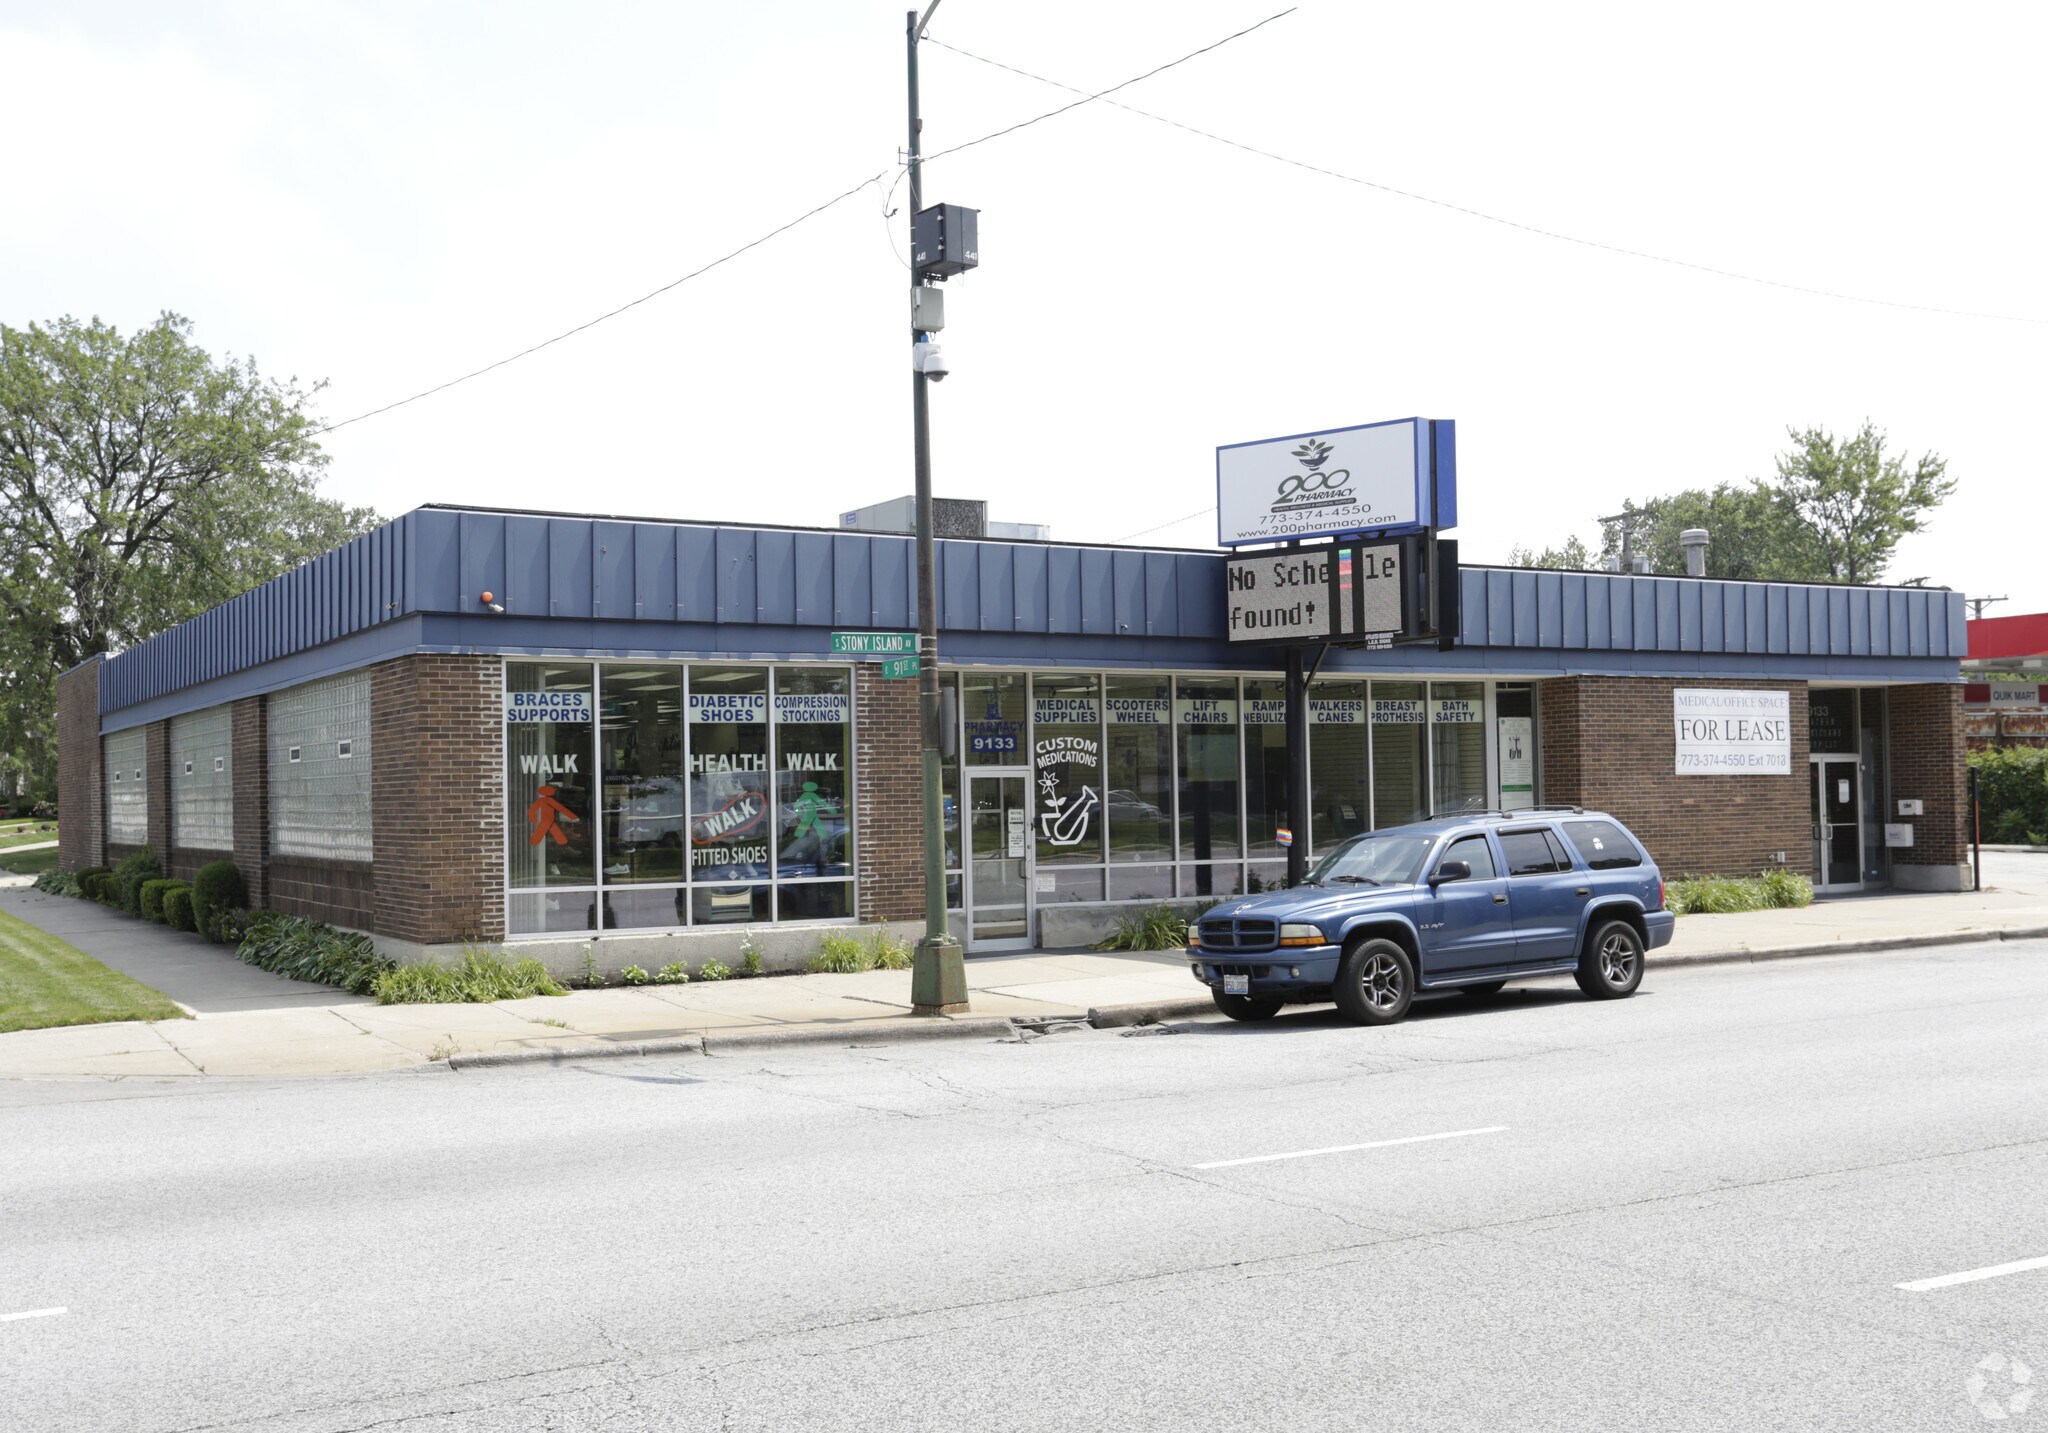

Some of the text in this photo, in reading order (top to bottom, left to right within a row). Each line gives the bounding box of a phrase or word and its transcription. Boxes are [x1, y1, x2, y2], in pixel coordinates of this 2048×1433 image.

[965, 250, 977, 260] 441
[1271, 469, 1350, 505] 200
[1294, 487, 1356, 502] PHARMACY
[1260, 504, 1371, 525] 773-374-4550
[1237, 515, 1396, 538] www.200pharmacy.com
[1228, 556, 1396, 591] No Schele
[835, 639, 839, 647] S
[841, 636, 869, 651] STONY
[873, 636, 903, 651] ISLAND
[514, 693, 583, 706] BRACES
[689, 696, 764, 708] DIABETIC
[775, 696, 847, 708] COMPRESSION
[1993, 691, 2036, 701] QUIK MART
[1036, 699, 1094, 710] MEDICAL
[1106, 699, 1169, 711] SCOOTERS
[1193, 700, 1218, 711] LIFT
[1252, 701, 1287, 711] RAMP
[1309, 701, 1362, 711] WALKERS
[1375, 701, 1417, 711] BREAST
[1442, 701, 1469, 711] BATH
[1758, 698, 1786, 708] SPACE
[508, 709, 590, 721] SUPPORTS
[701, 709, 754, 722] SHOES
[782, 710, 841, 722] STOCKINGS
[1034, 711, 1097, 723] SUPPLIES
[1116, 711, 1159, 723] WHEEL
[1183, 712, 1228, 723] CHAIRS
[1244, 712, 1287, 722] NEBULIZ
[1317, 712, 1354, 722] CANES
[1371, 712, 1424, 722] PROTHESIS
[1436, 712, 1475, 722] SAFETY
[964, 721, 1025, 733] PHARMACY
[1680, 719, 1786, 741] FOR LEASE
[974, 738, 1014, 749] 9133
[1036, 737, 1098, 753] CUSTOM
[520, 754, 579, 774] WALK
[690, 754, 767, 772] HEALTH
[786, 753, 837, 771] WALK
[1037, 751, 1098, 769] MEDICATIONS
[1681, 754, 1746, 767] 773-374-4550
[1748, 754, 1763, 766] Ext
[704, 797, 758, 837] WALK
[691, 846, 768, 866] FITTED SHOES
